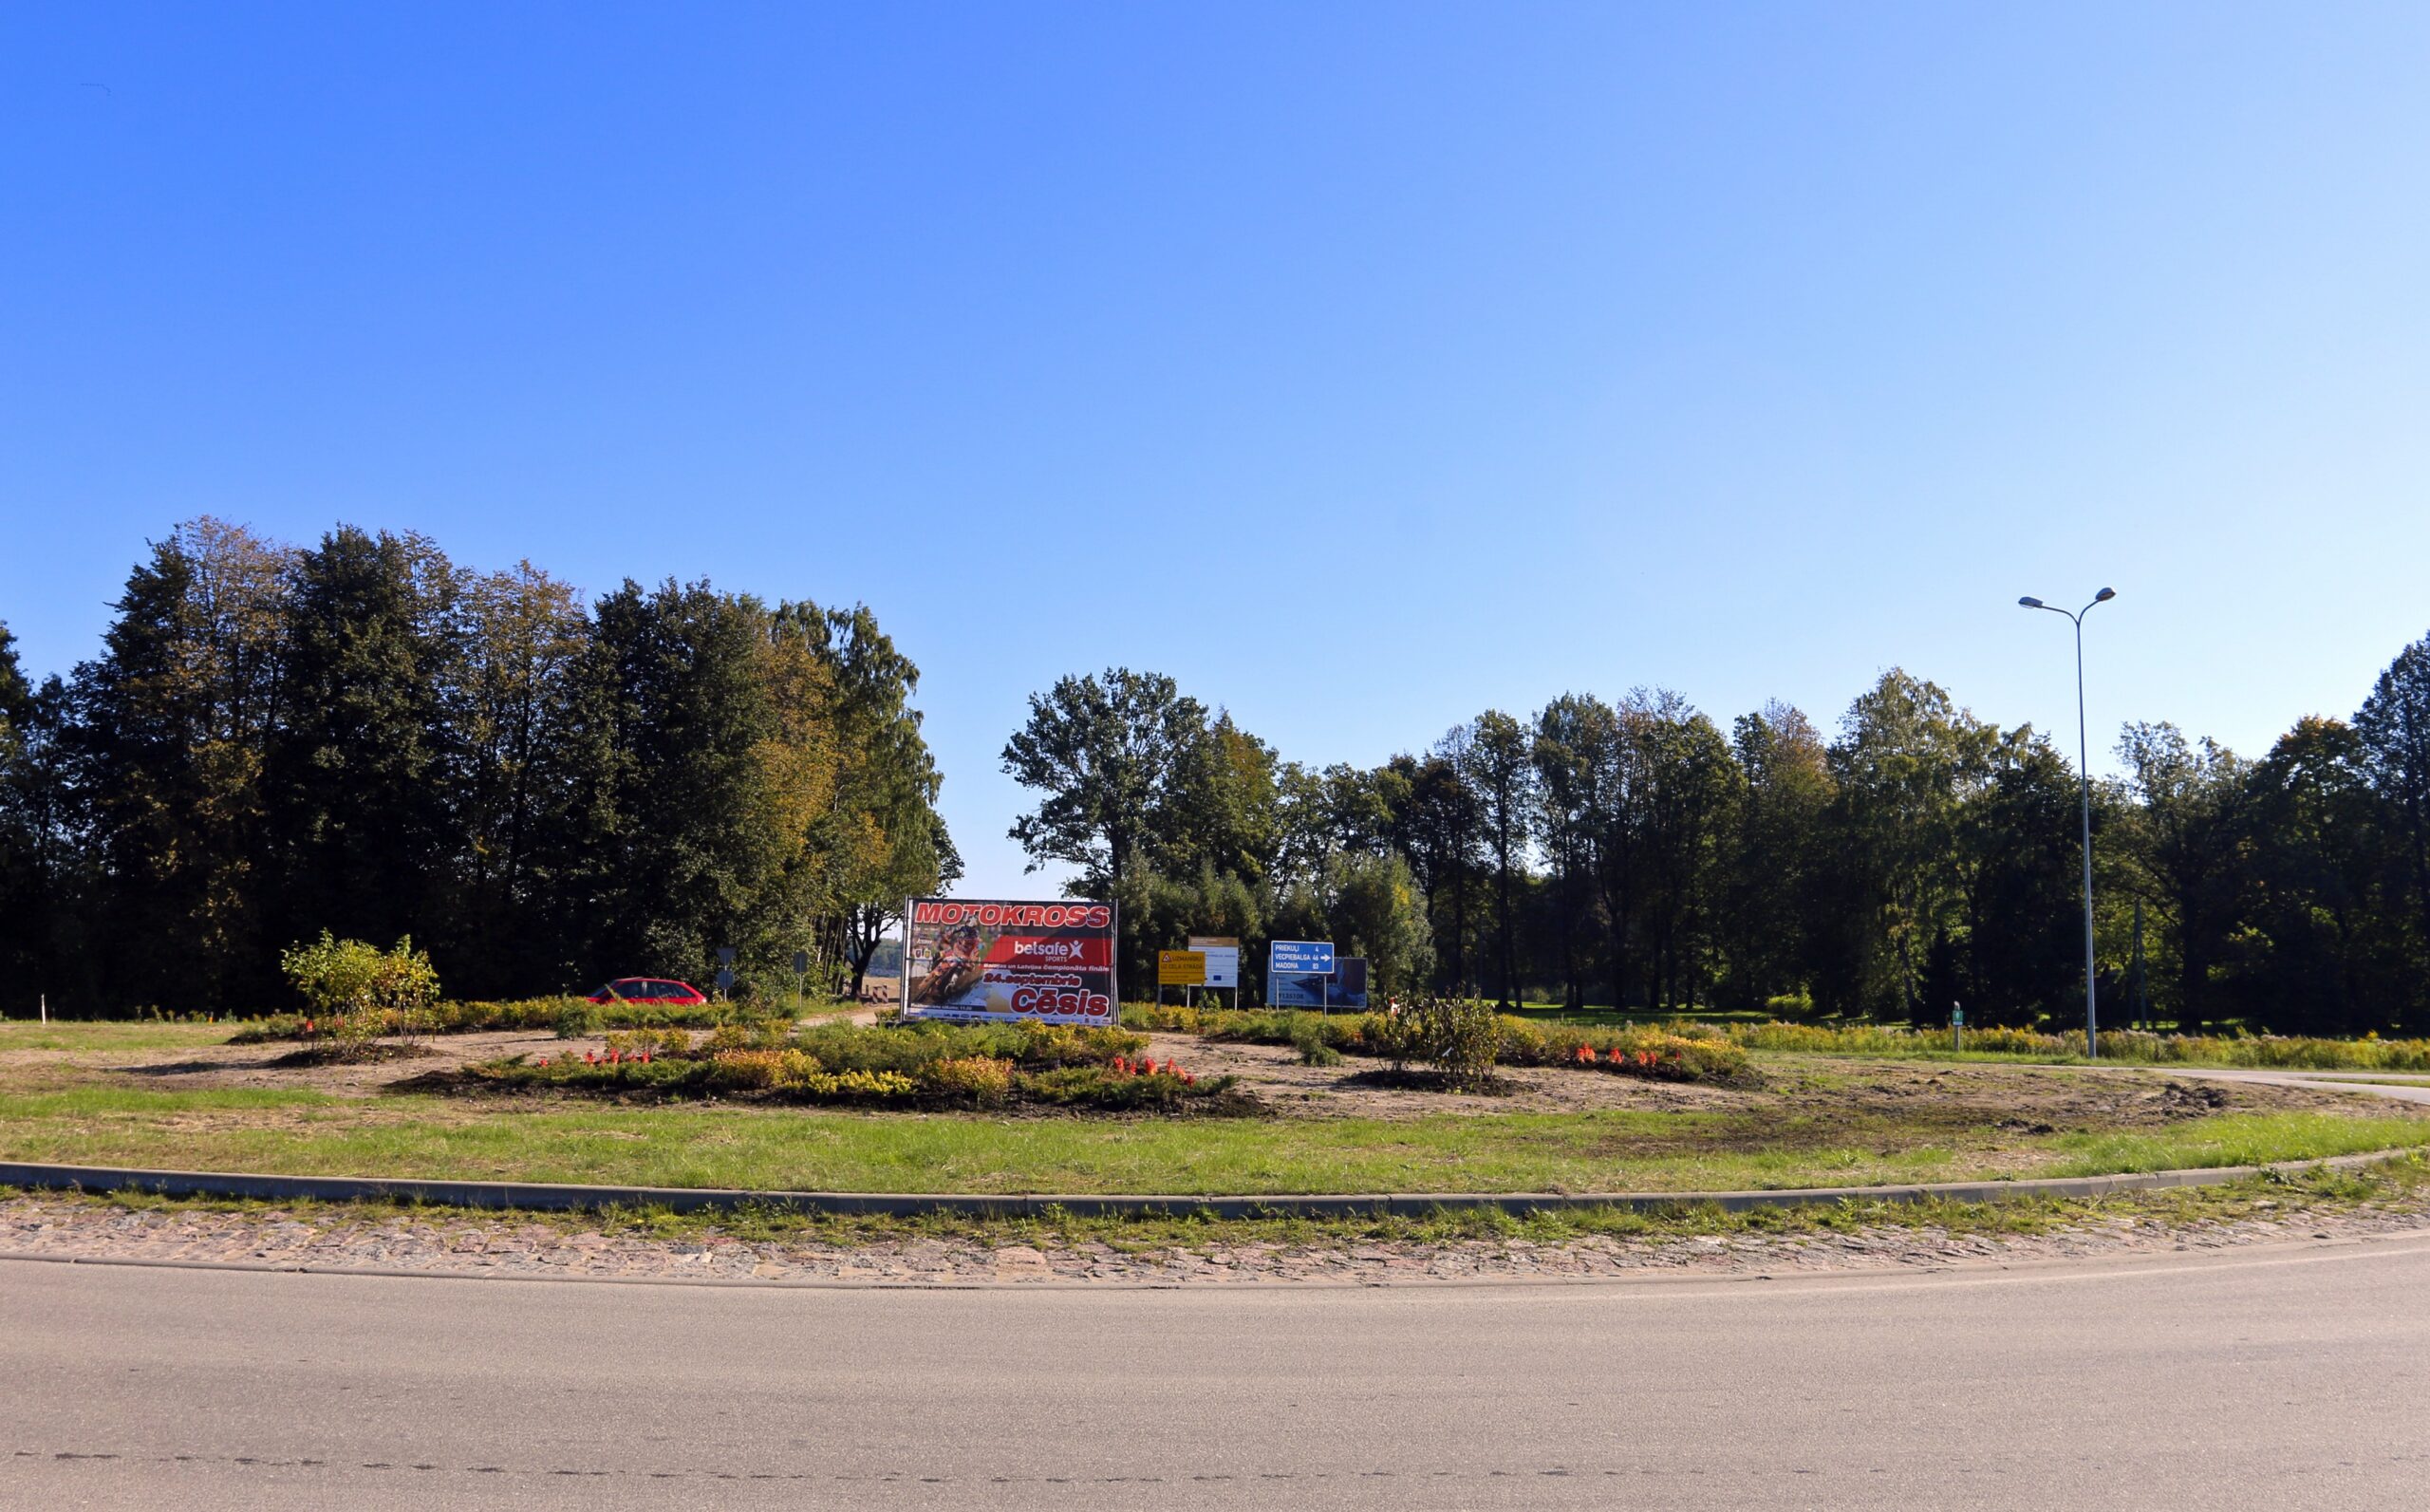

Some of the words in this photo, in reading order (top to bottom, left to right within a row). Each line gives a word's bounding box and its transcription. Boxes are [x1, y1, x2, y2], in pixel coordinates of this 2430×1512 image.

[915, 903, 1111, 928] MOTOKROSS
[1015, 941, 1069, 956] betsafe
[1010, 987, 1110, 1016] Cēsis
